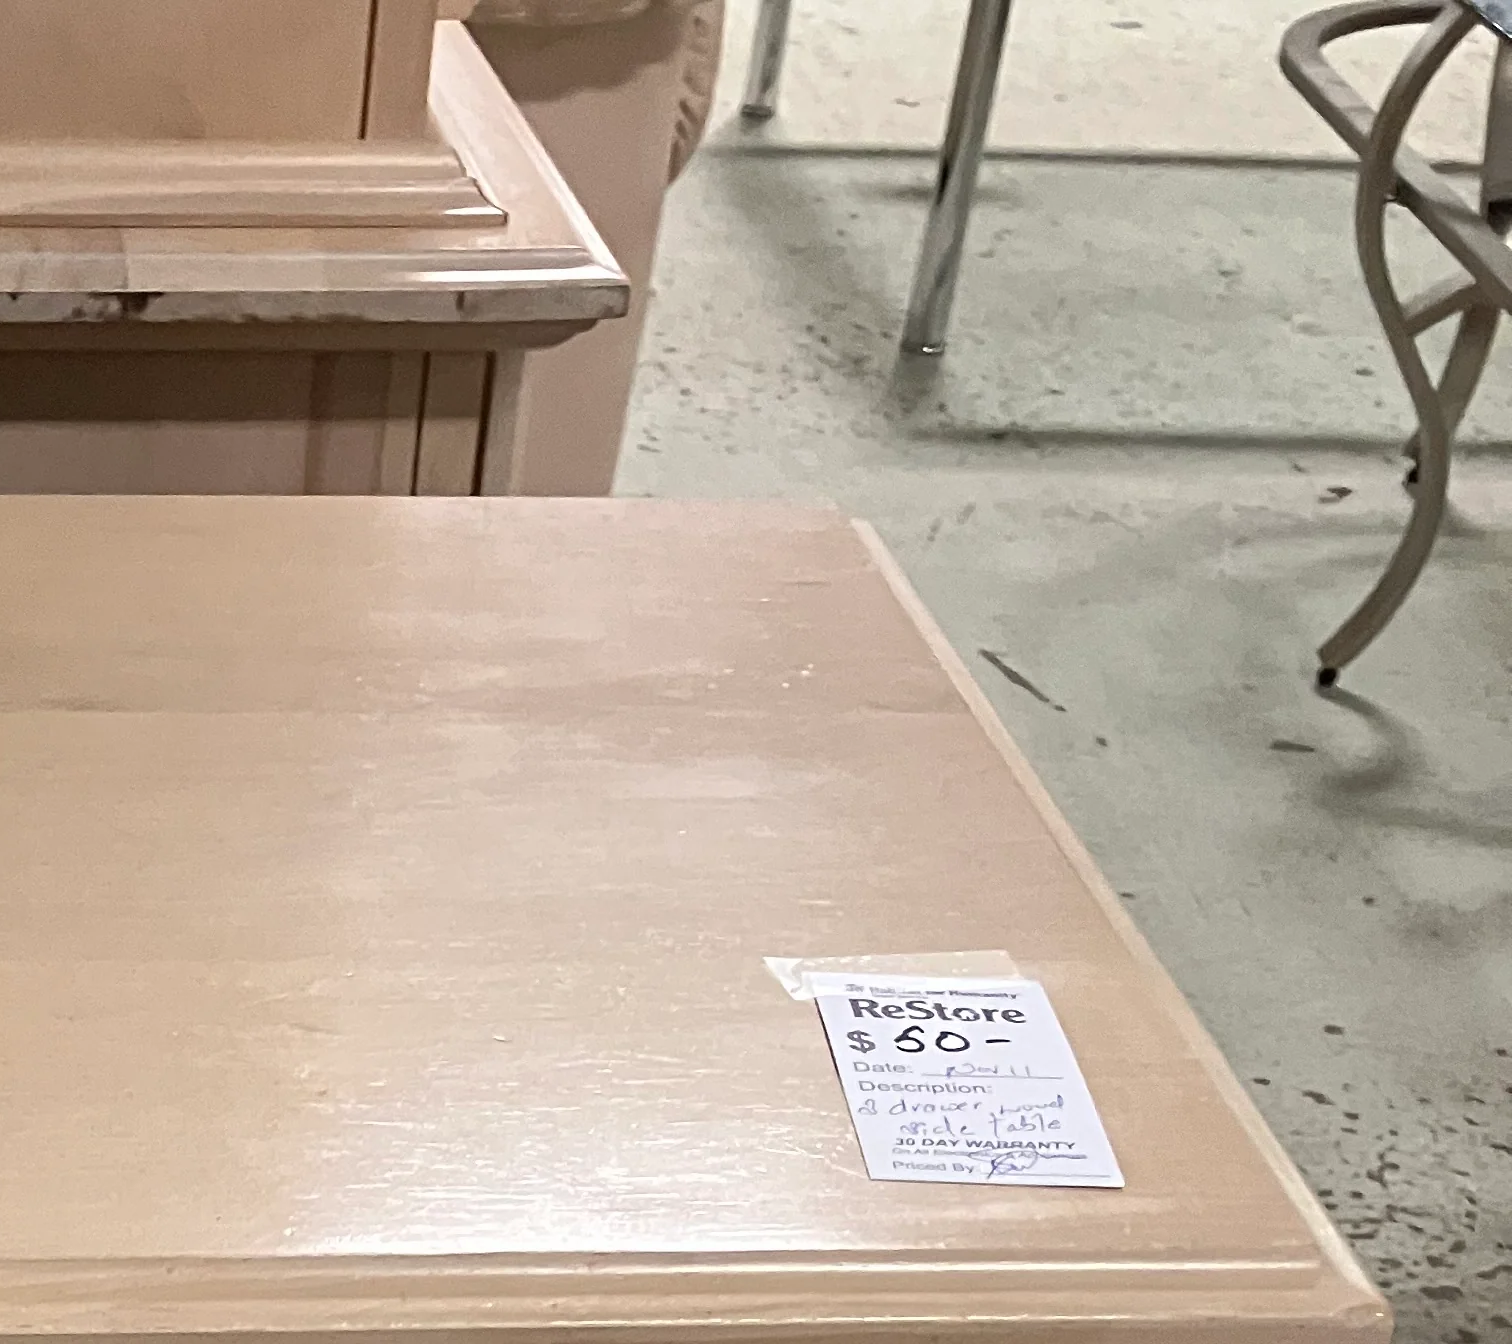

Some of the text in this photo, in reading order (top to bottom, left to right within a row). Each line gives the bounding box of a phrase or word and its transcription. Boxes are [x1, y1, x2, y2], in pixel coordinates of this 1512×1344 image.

[848, 998, 1027, 1024] ReStore
[853, 1061, 914, 1074] Date:
[858, 1080, 993, 1095] Description:
[921, 1137, 960, 1148] DAY
[965, 1139, 1076, 1150] WARRANTY
[892, 1160, 947, 1172] Priced
